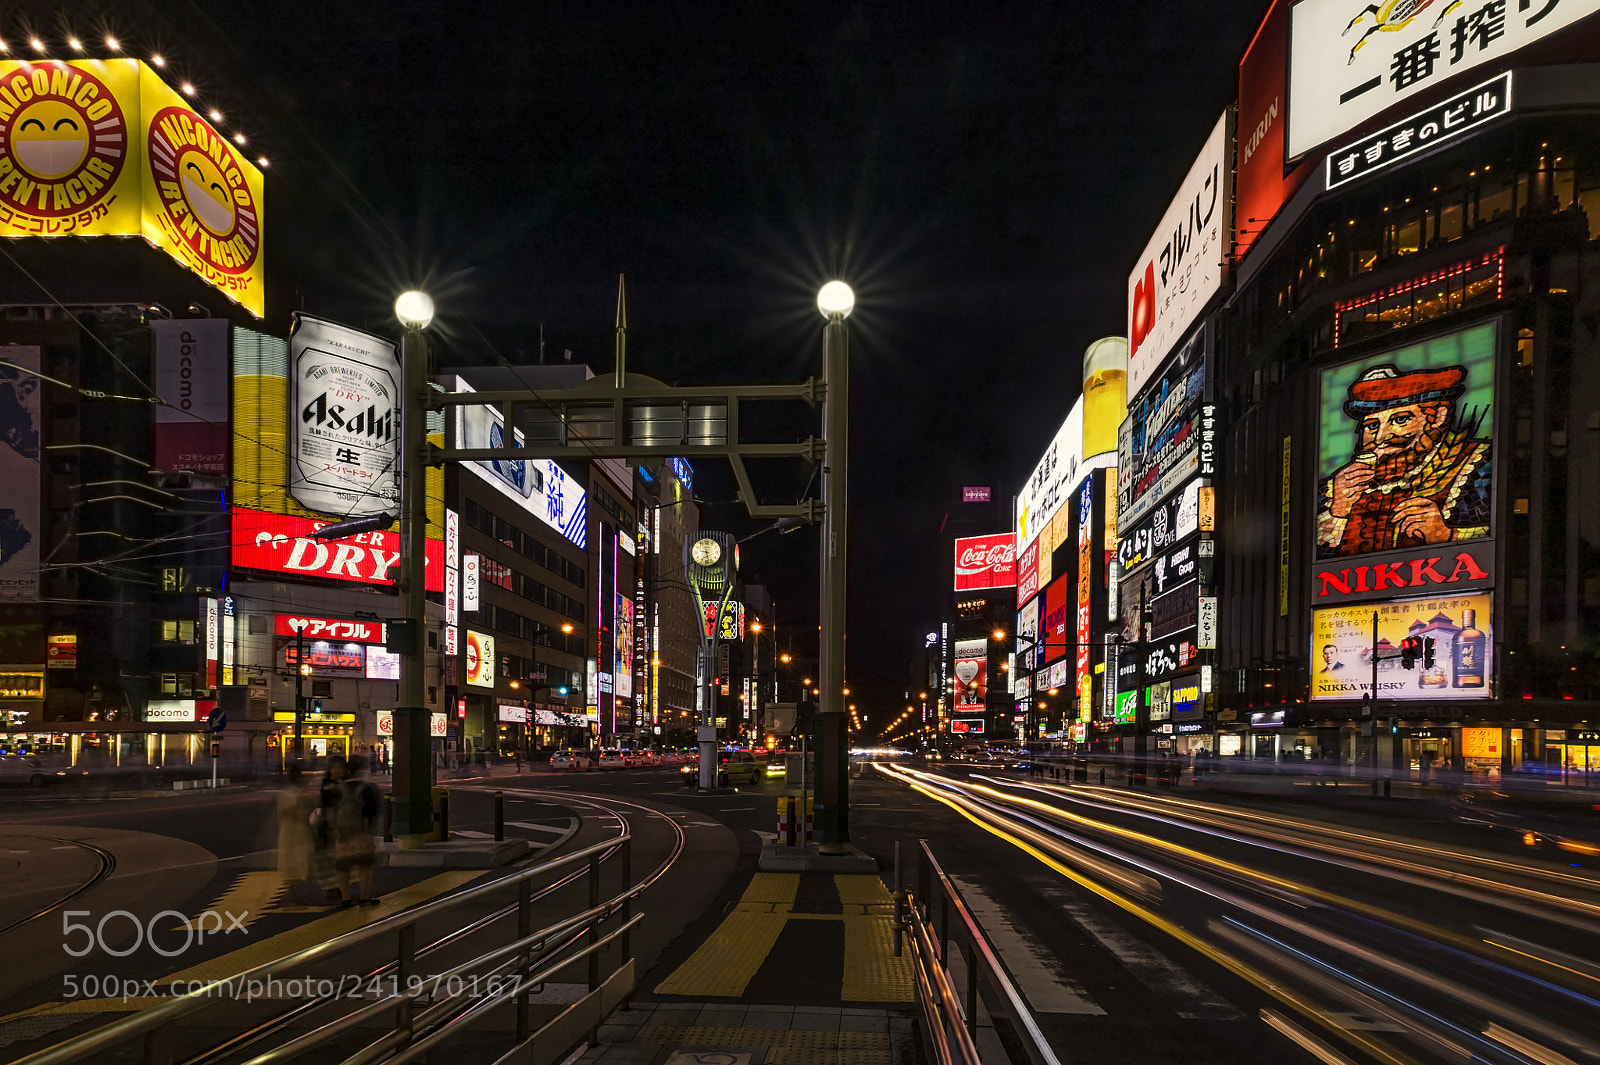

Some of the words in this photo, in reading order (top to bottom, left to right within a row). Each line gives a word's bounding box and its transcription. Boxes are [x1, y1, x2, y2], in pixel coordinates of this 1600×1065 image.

[0, 69, 112, 122] NICONICO
[1244, 96, 1279, 164] KIRIN
[1337, 92, 1497, 175] すすきのビル
[159, 114, 250, 207] NICONICO
[0, 156, 115, 211] RENTACAR
[0, 195, 117, 234] コニコレンタカー
[160, 180, 251, 268] RENTACAR
[1159, 162, 1219, 289] マルハン
[157, 212, 253, 290] ニコニコレンタカー
[180, 331, 196, 410] docomo
[313, 368, 328, 380] ASAHI
[330, 366, 363, 380] BREWERIES
[365, 377, 382, 397] LIMITED
[302, 392, 391, 441] Asahi
[178, 453, 224, 462] ドコモショップ
[336, 448, 360, 466] 生
[1201, 405, 1215, 474] すすきのビル
[324, 463, 373, 479] スーパードライ
[546, 476, 565, 529] 純
[1031, 453, 1077, 534] サッポロビール
[314, 522, 385, 547] SER
[960, 544, 1015, 568] Coca-Cola
[1317, 552, 1490, 597] NIKKA
[1416, 599, 1471, 612] 竹鶴政孝の
[209, 608, 217, 650] docomo
[309, 619, 371, 639] アイフル
[958, 647, 984, 655] docomo
[1173, 686, 1199, 703] SAPPORO
[1318, 684, 1357, 692] NIKKA
[147, 708, 189, 717] docomo
